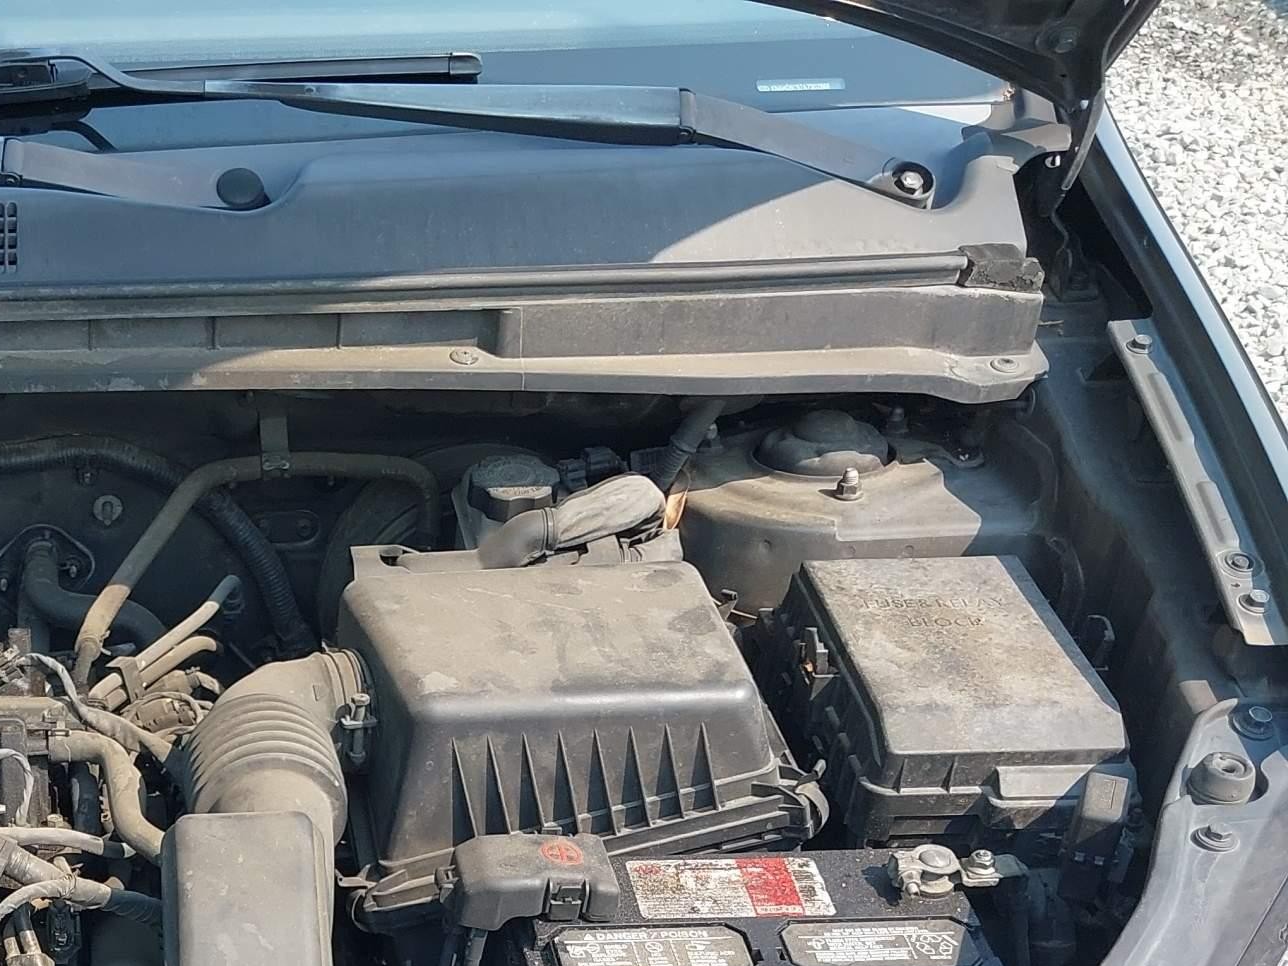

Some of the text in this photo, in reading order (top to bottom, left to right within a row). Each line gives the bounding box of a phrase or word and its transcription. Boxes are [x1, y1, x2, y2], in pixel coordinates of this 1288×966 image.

[863, 599, 916, 608] FUSE
[935, 598, 1003, 608] RELAY
[908, 617, 984, 627] BLOCK
[596, 931, 647, 940] DANGER
[661, 930, 708, 938] POISON
